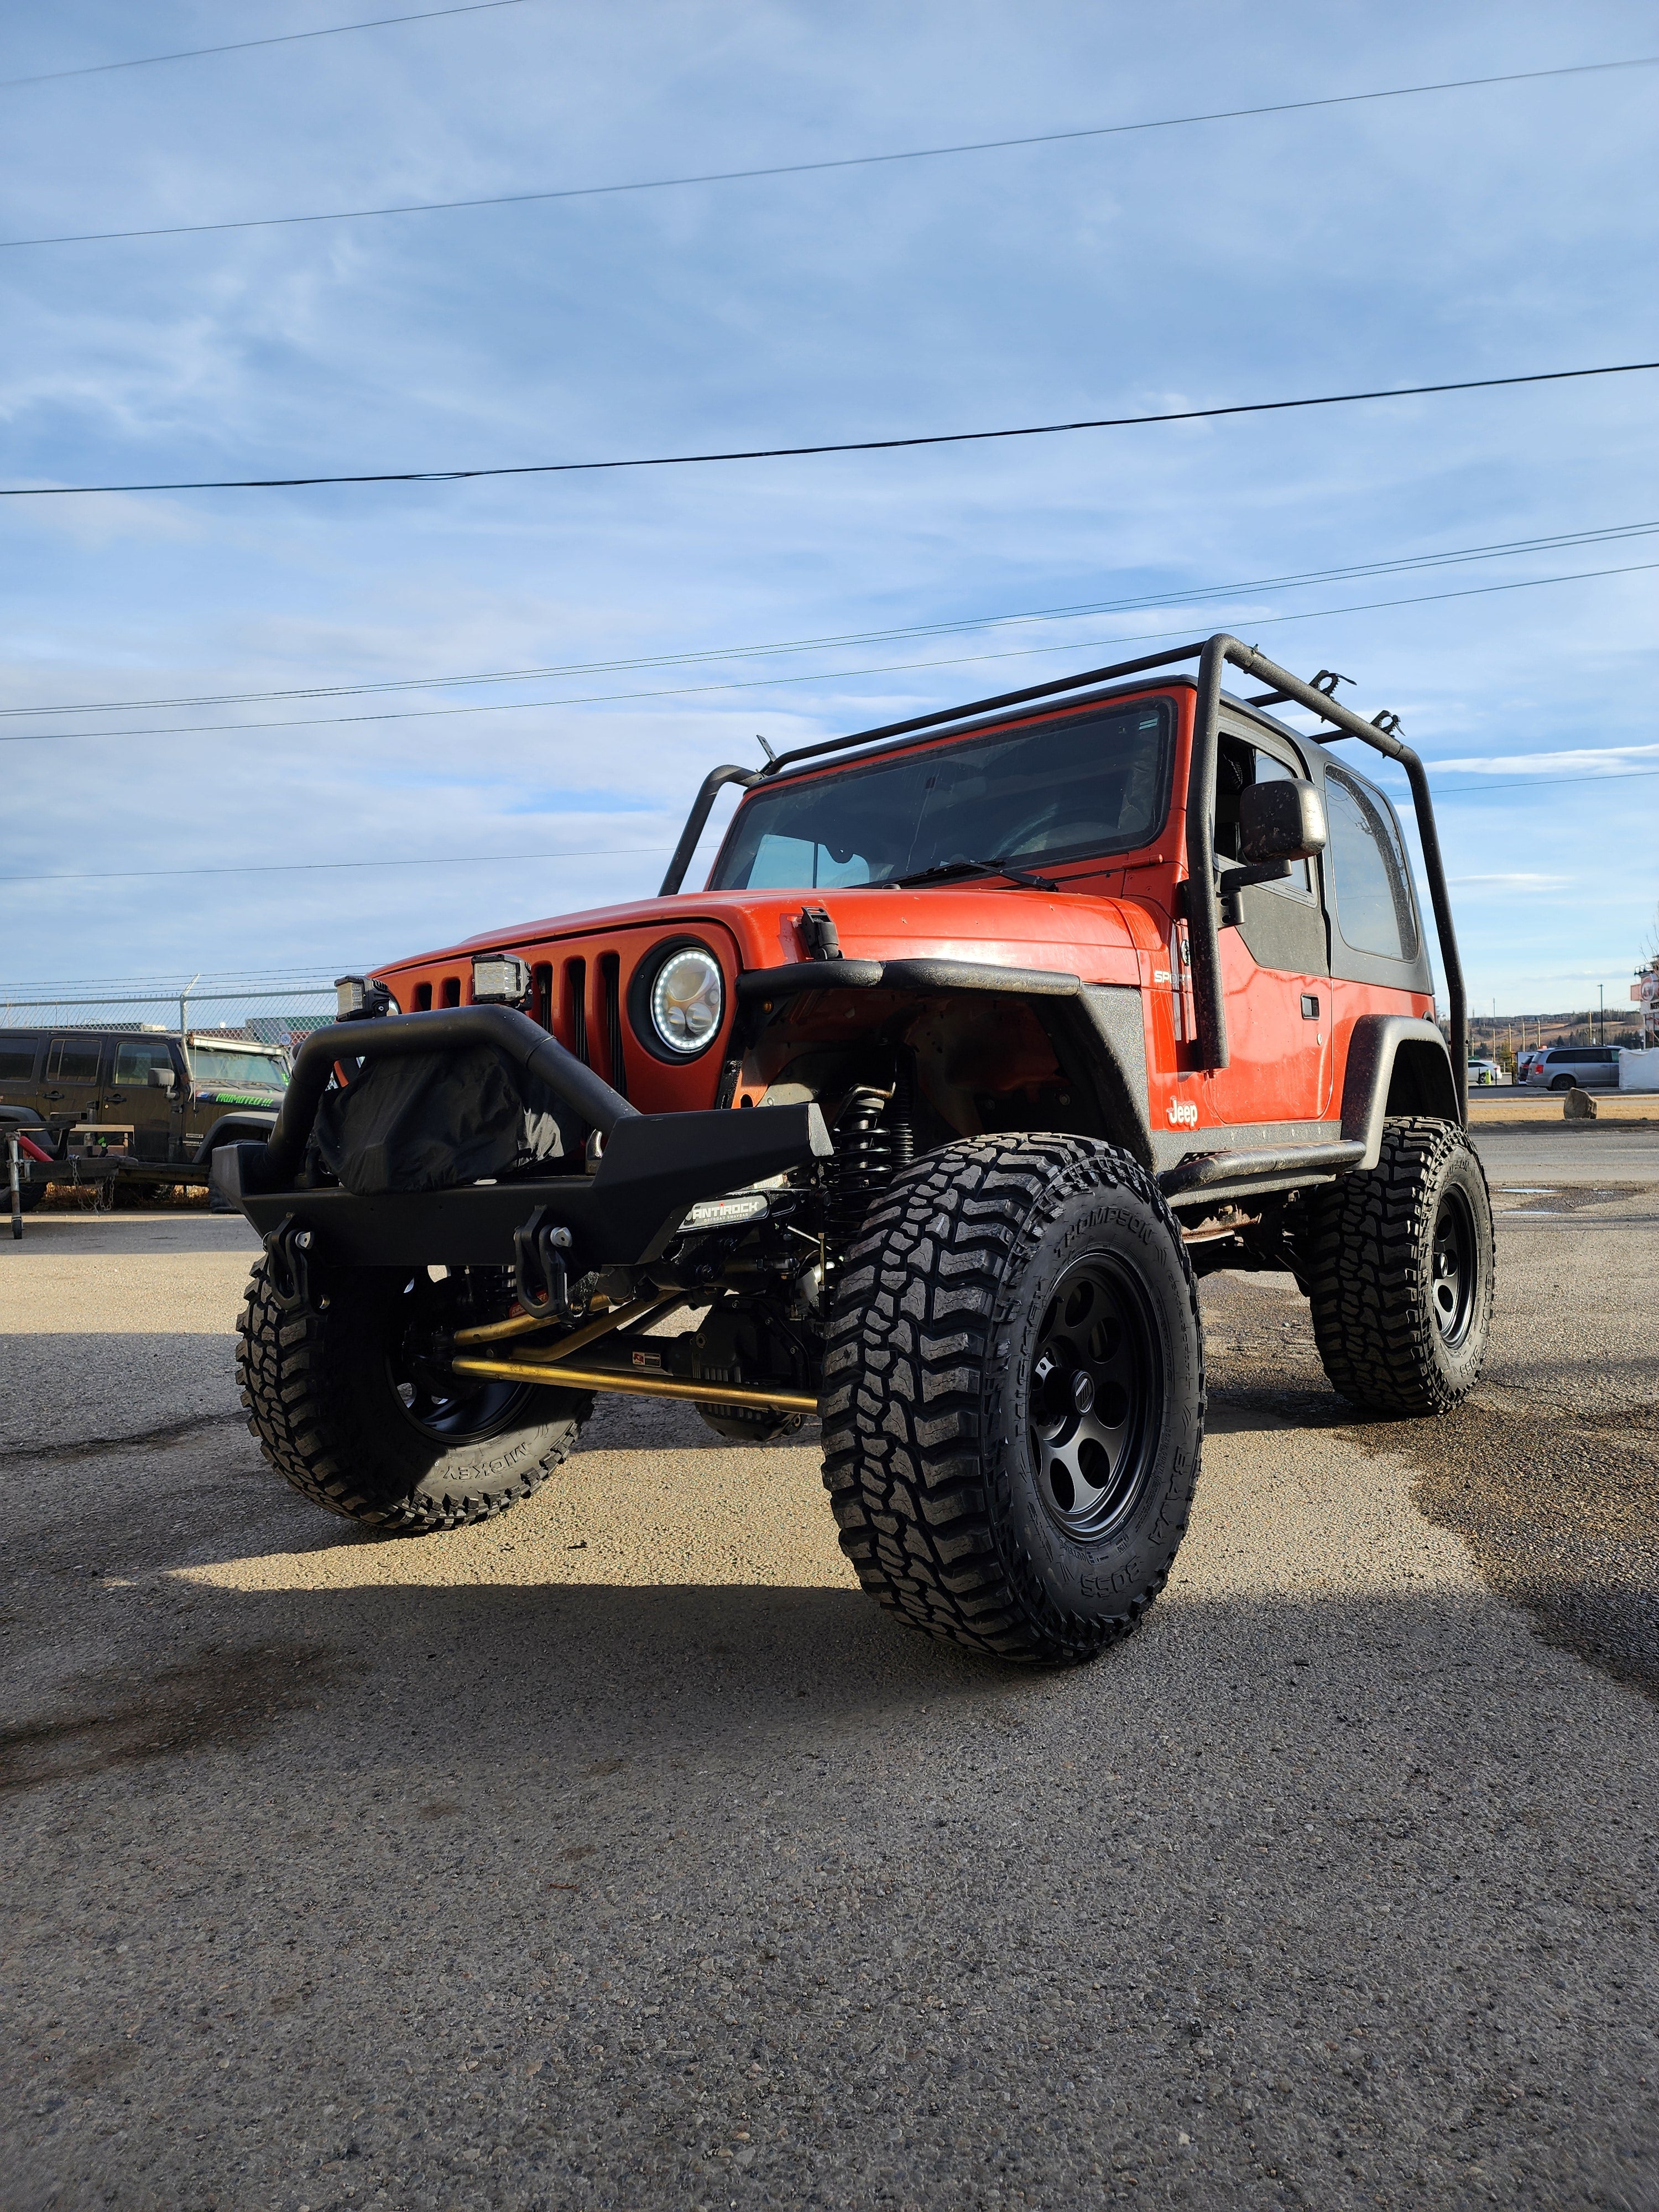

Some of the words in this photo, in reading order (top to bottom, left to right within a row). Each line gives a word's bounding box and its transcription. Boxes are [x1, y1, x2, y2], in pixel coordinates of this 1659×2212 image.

[1166, 1095, 1198, 1127] Jeep
[1052, 1205, 1157, 1259] THOMPSON
[442, 1441, 535, 1480] MICKEY
[1147, 1445, 1186, 1546] BAJA
[1080, 1555, 1141, 1598] BOSS
